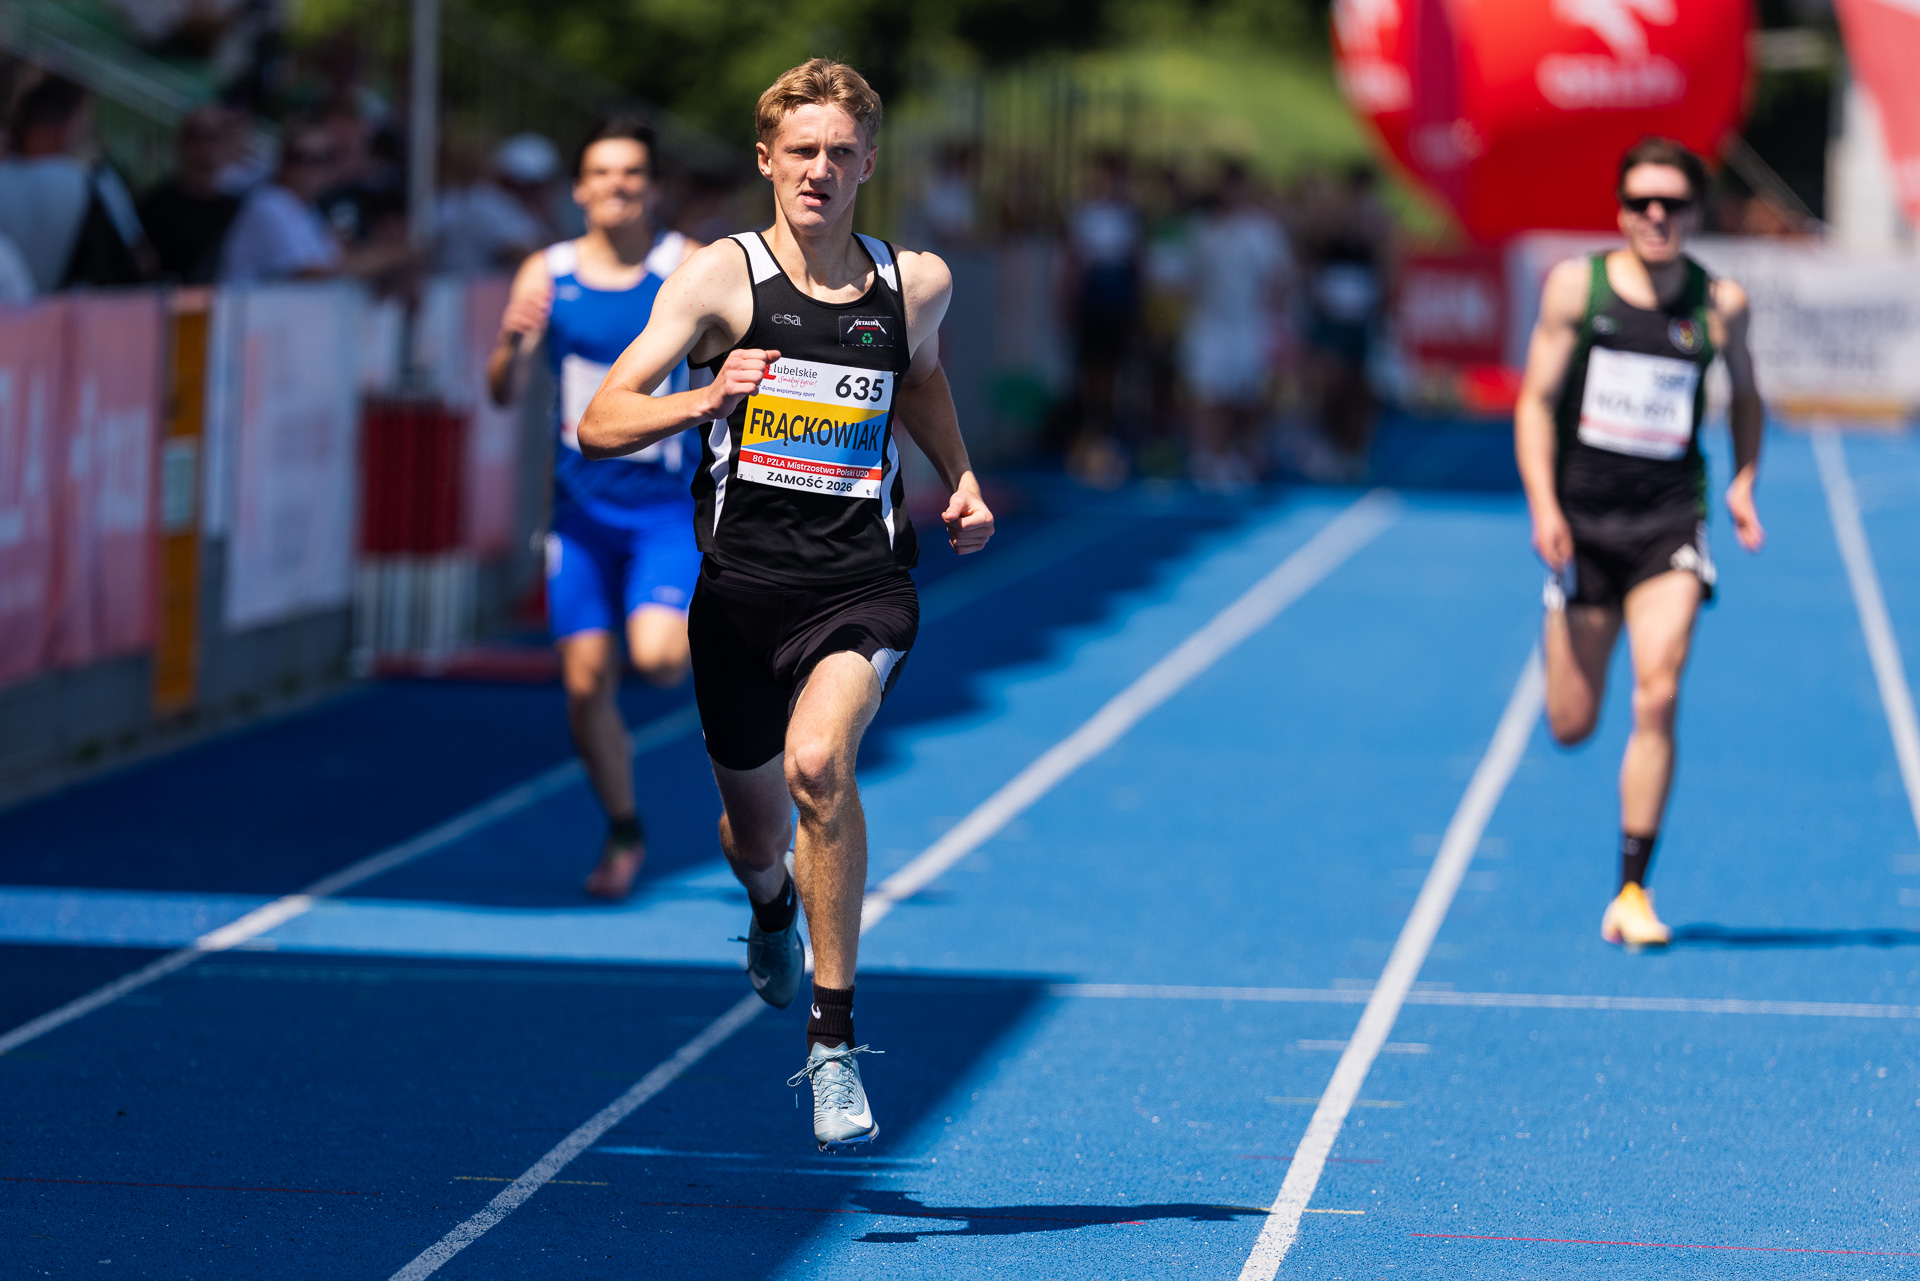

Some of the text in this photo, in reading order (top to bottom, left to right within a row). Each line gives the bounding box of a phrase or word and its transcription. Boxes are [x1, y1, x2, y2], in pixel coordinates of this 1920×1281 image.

[771, 313, 802, 326] esa
[773, 363, 818, 379] lubelskie
[776, 387, 802, 397] wspieramy
[802, 390, 816, 398] sport
[835, 374, 885, 403] 635
[749, 407, 882, 452] FRĄCKOWIAK
[752, 454, 870, 479] 80. PZLA Mistrzostwa Polski U20
[766, 471, 853, 493] ZAMOŚĆ 2026
